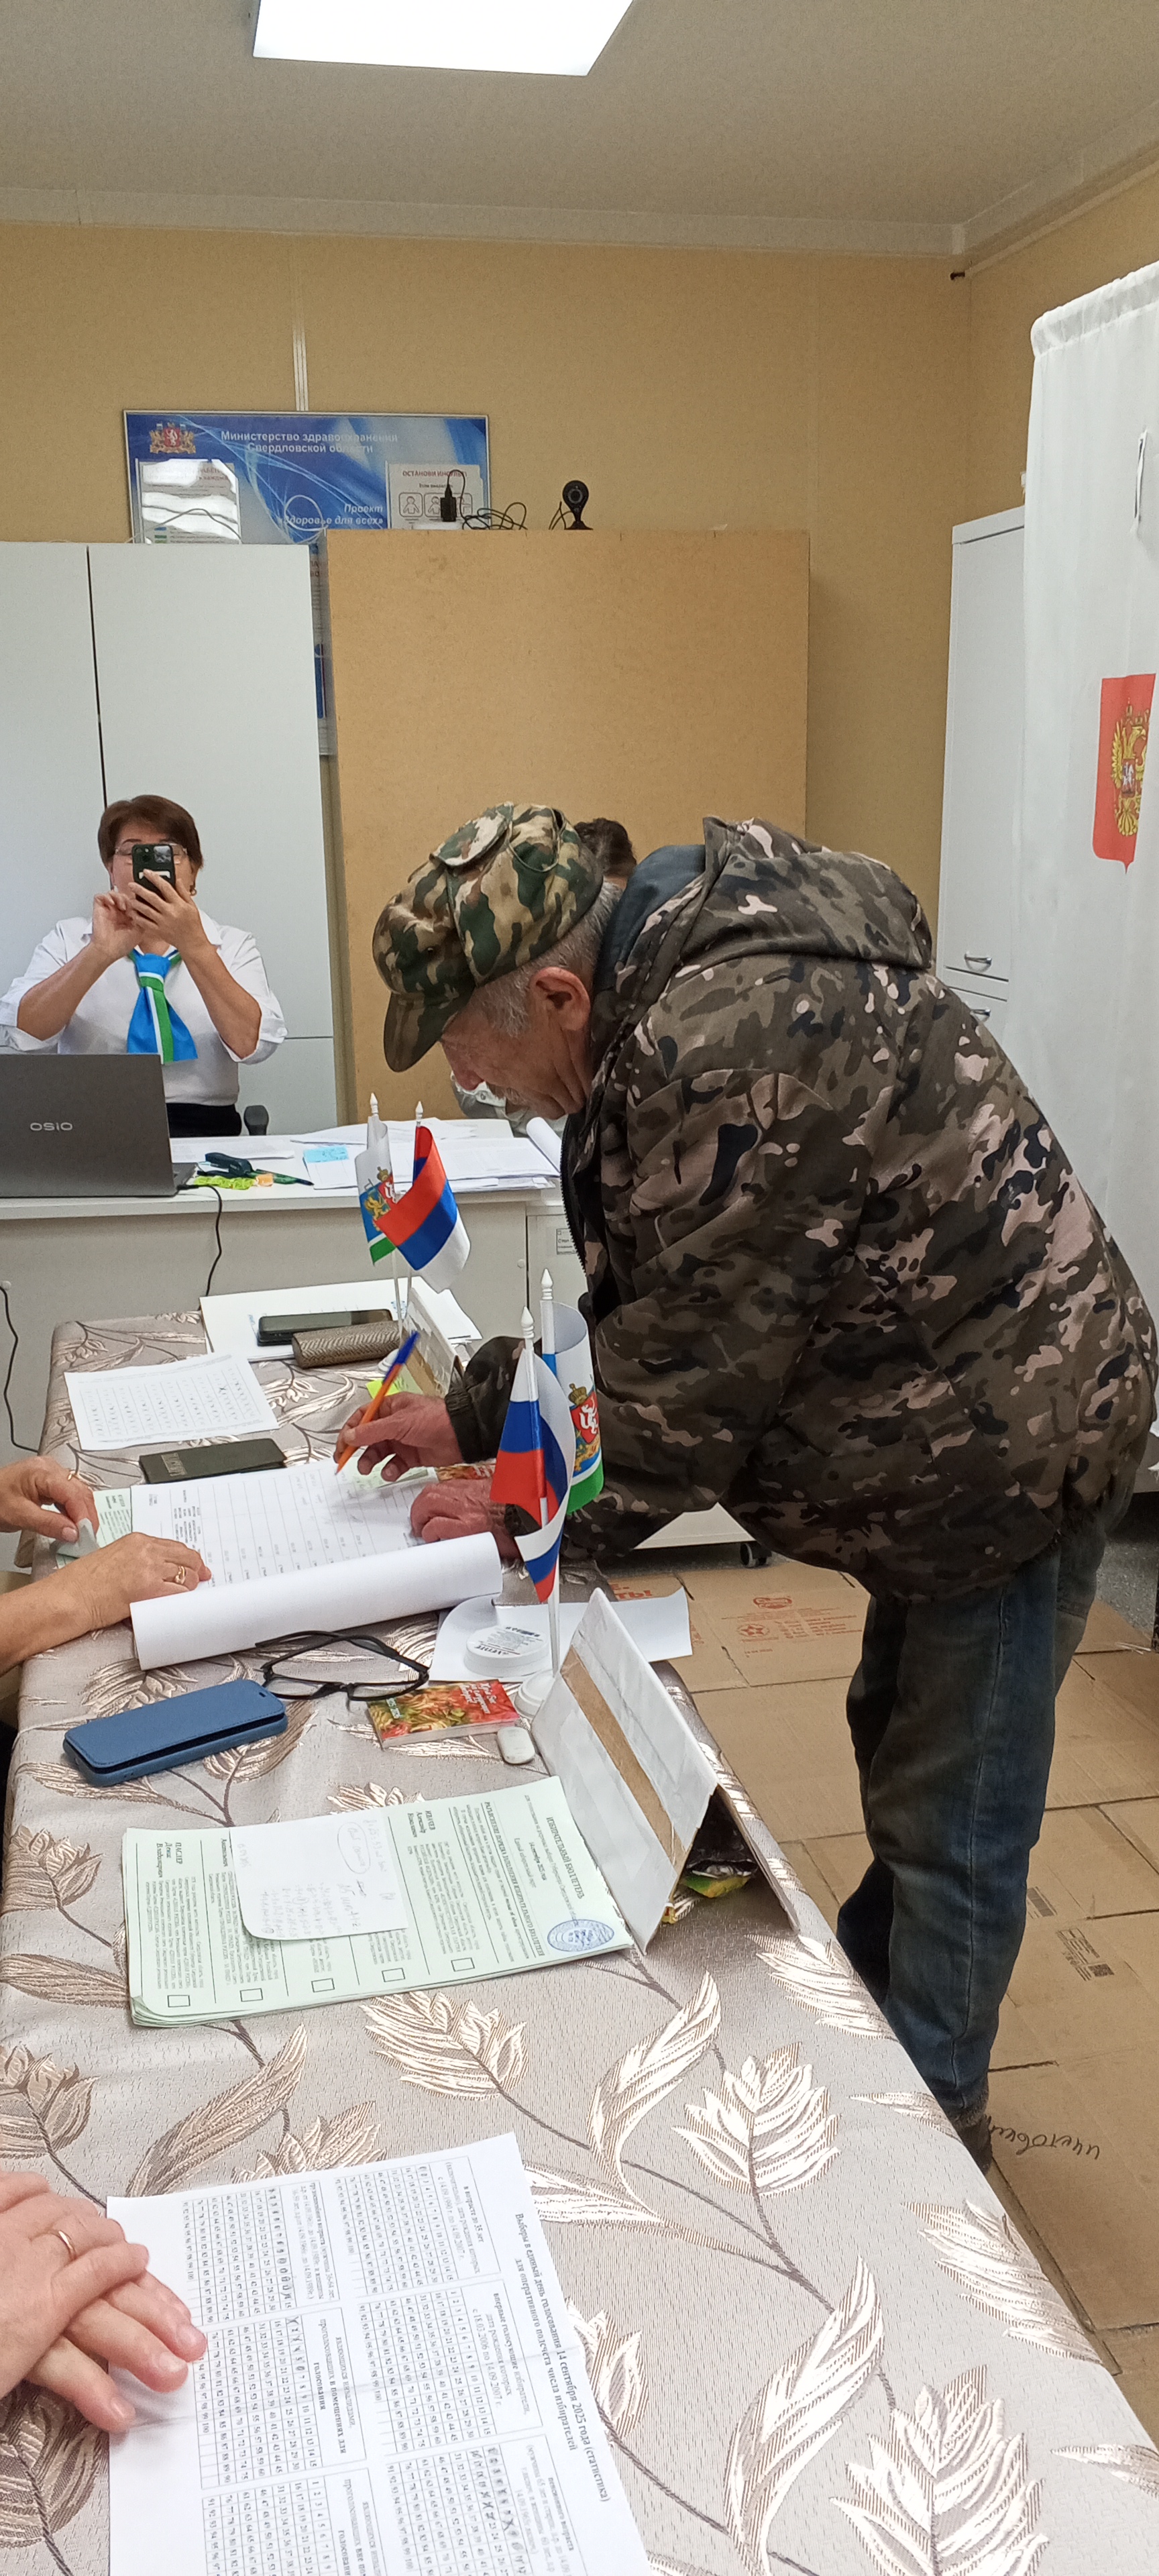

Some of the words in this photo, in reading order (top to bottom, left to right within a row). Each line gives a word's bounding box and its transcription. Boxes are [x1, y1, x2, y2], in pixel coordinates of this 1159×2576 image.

[221, 431, 299, 443] Министерство
[247, 442, 326, 453] Свердловской
[335, 515, 353, 525] для
[344, 504, 383, 513] Проект
[30, 1122, 72, 1131] OSIO
[473, 2223, 483, 2232] 35
[512, 2212, 531, 2243] Выборы
[514, 2258, 525, 2272] для
[525, 2248, 543, 2278] единый
[516, 2272, 541, 2328] оперативного
[533, 2278, 547, 2298] день
[491, 2292, 506, 2323] впервые
[540, 2298, 562, 2349] голосования
[472, 2314, 490, 2351] 18.03.2006
[484, 2361, 503, 2400] 14.09.2007
[498, 2323, 519, 2371] голосующие
[534, 2328, 552, 2366] подсчета
[555, 2350, 567, 2360] 14
[487, 2328, 504, 2365] рождения
[496, 2364, 512, 2397] которых
[313, 2361, 327, 2410] голосования
[545, 2367, 560, 2393] числа
[557, 2361, 580, 2402] сентября
[551, 2394, 579, 2451] избирателей
[571, 2402, 587, 2424] 2025
[337, 2438, 347, 2455] для
[576, 2425, 591, 2446] года
[582, 2445, 612, 2503] (статистика)
